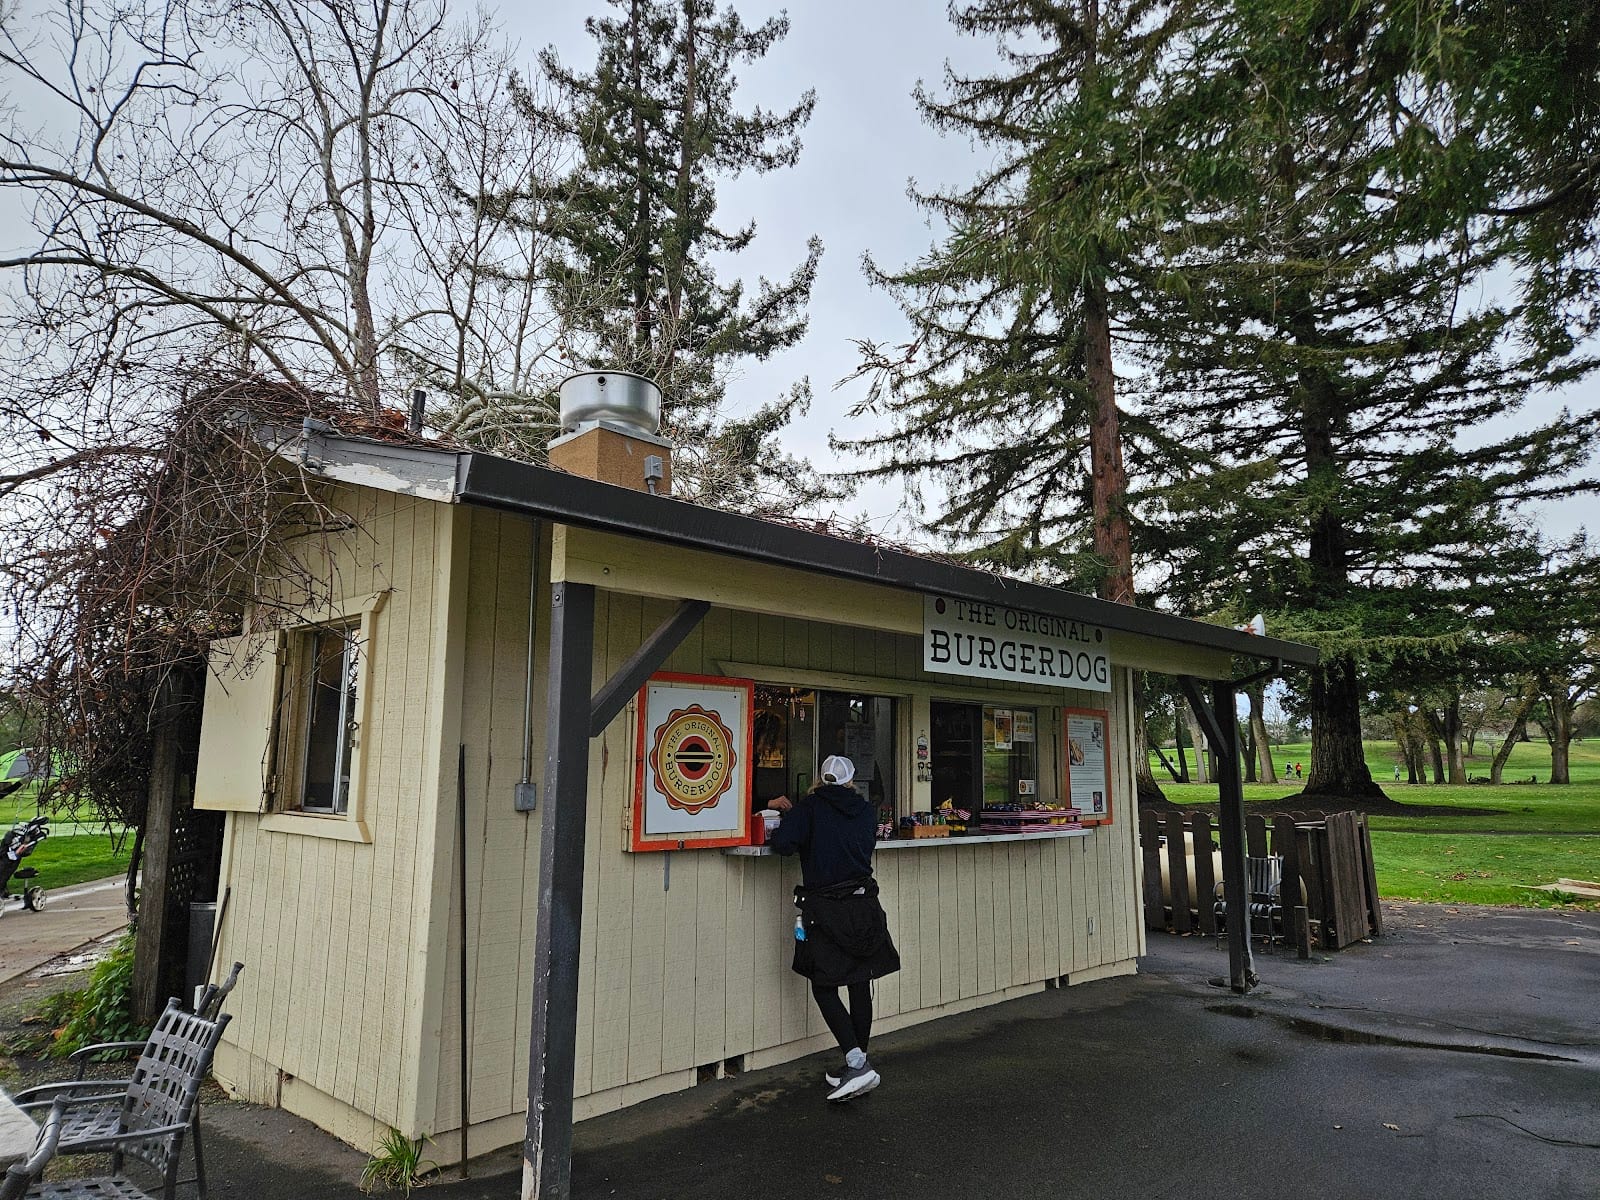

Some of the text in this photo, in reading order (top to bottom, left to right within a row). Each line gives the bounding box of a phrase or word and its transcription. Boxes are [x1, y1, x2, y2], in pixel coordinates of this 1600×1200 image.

[953, 599, 1090, 643] THE ORIGINAL
[930, 629, 1107, 684] BURGERDOG
[667, 721, 720, 751] THE ORIGINAL
[665, 760, 724, 796] BURGERDOG
